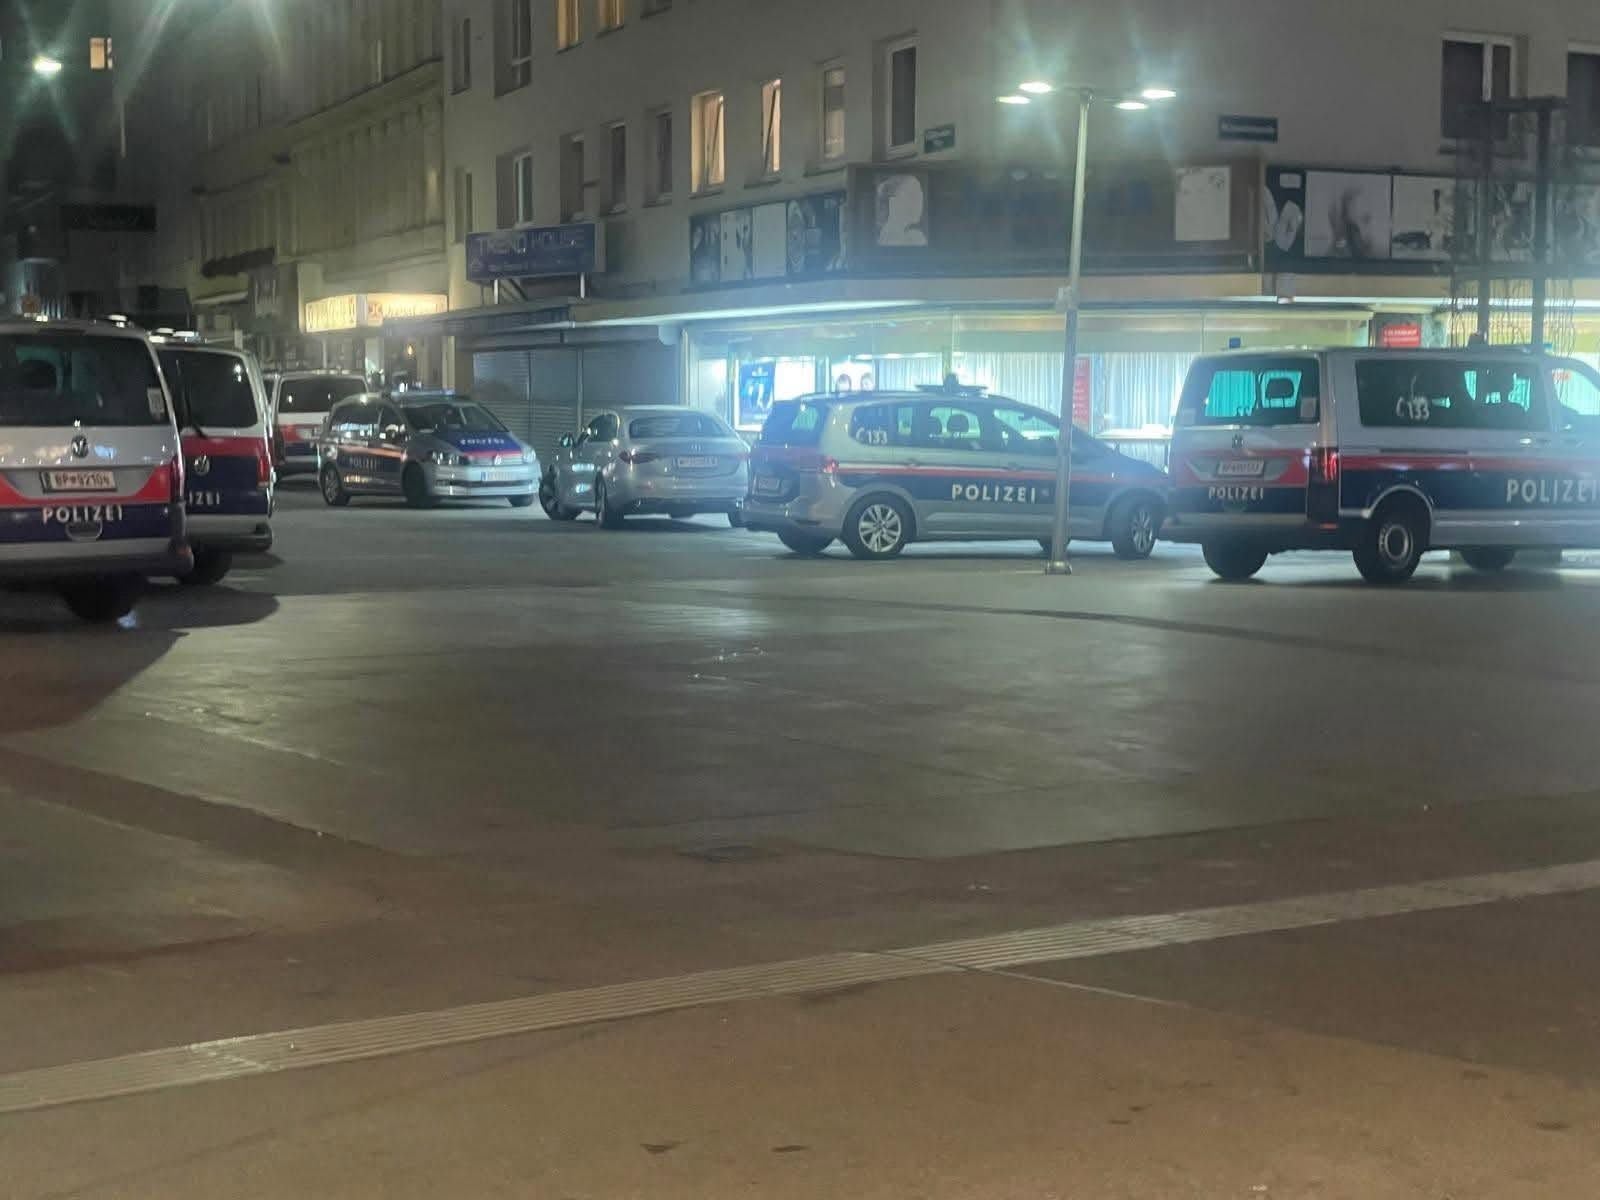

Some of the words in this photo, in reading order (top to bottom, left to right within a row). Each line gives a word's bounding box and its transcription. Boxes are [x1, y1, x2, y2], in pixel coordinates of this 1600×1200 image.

[1408, 397, 1430, 420] 133
[867, 430, 888, 444] 133
[951, 483, 1036, 504] POLIZEI
[1208, 486, 1264, 501] POLIZEI
[1506, 479, 1597, 505] POLIZEI
[41, 505, 124, 525] POLIZEI
